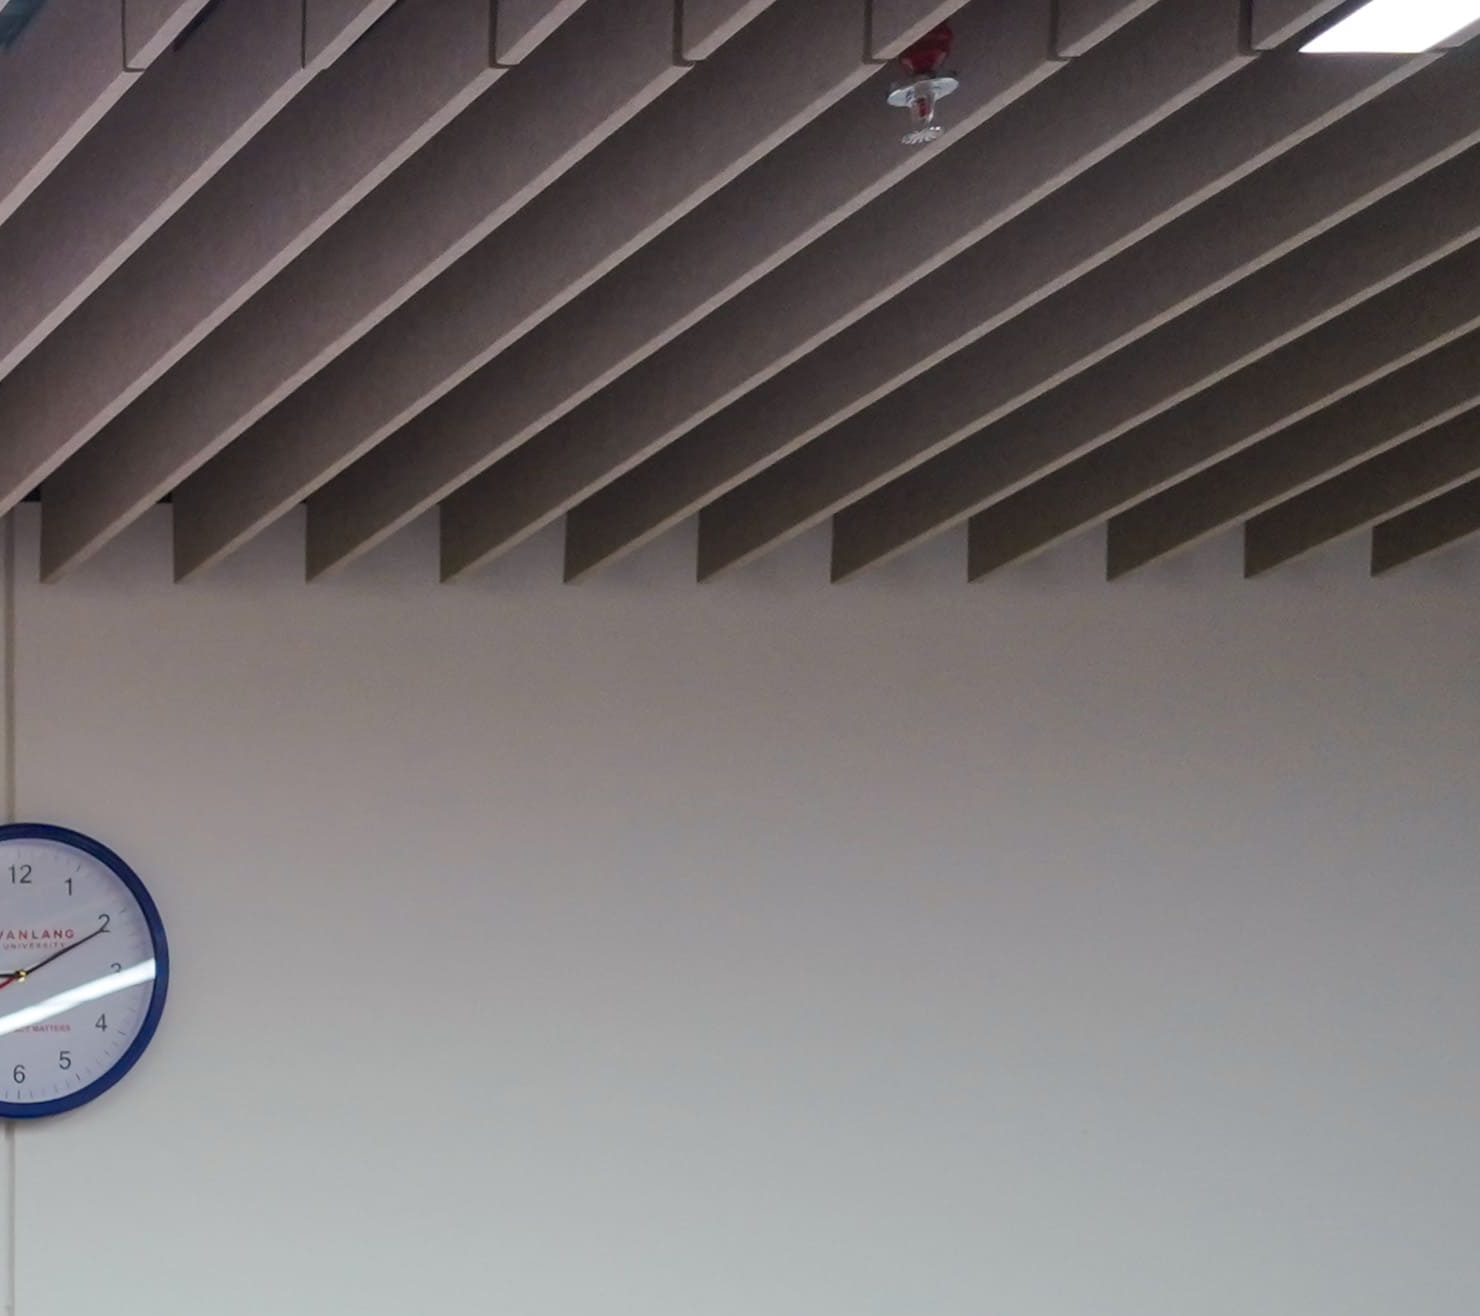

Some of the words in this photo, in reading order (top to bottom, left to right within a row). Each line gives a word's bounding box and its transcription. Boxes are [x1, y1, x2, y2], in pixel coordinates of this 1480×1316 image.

[10, 865, 32, 884] 12
[96, 1014, 107, 1032] 4
[59, 1051, 71, 1070] 5
[14, 1065, 25, 1084] 6
